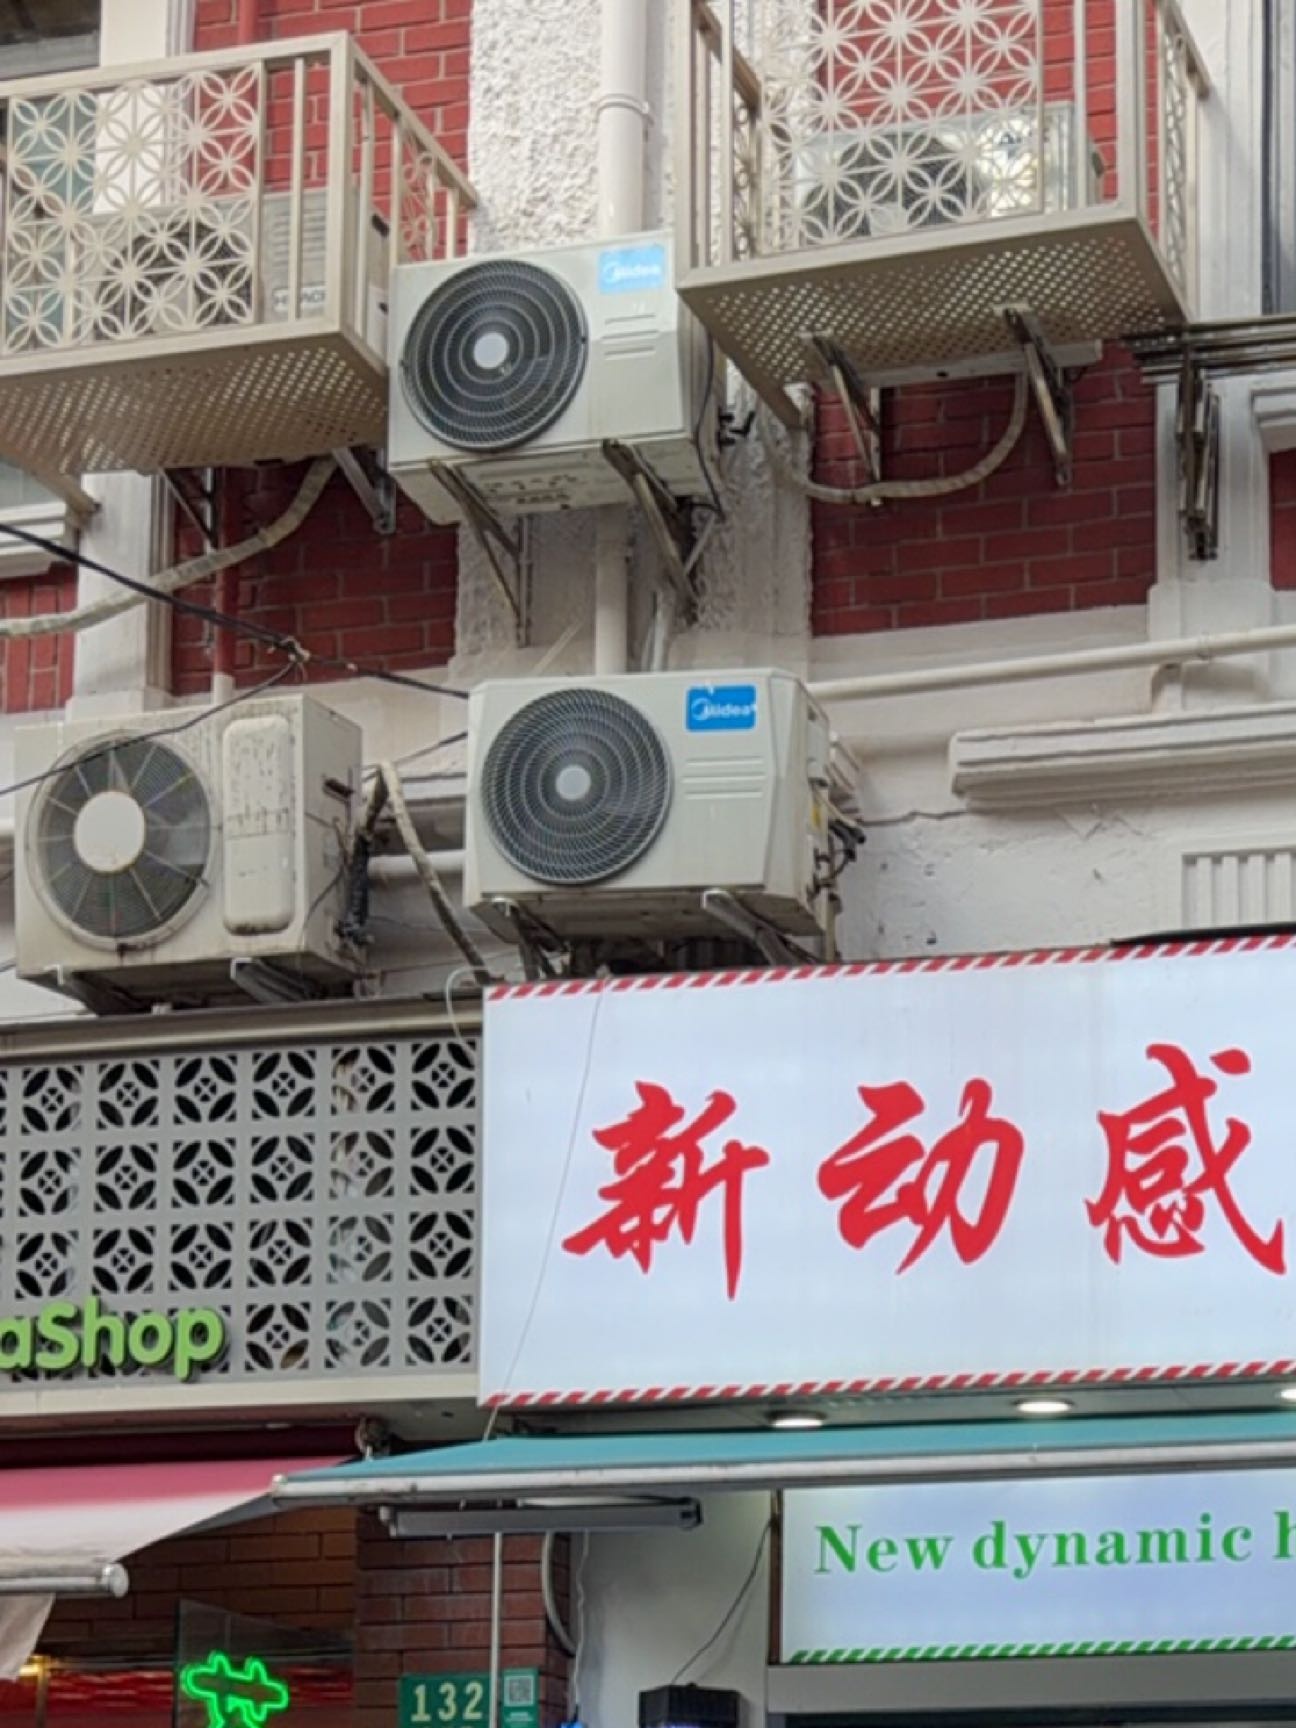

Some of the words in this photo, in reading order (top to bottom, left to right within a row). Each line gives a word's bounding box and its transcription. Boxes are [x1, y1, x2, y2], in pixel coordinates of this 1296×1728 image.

[696, 699, 751, 721] Midea
[815, 1522, 955, 1576] New
[969, 1508, 1257, 1584] dynamic
[410, 1681, 484, 1722] 132
